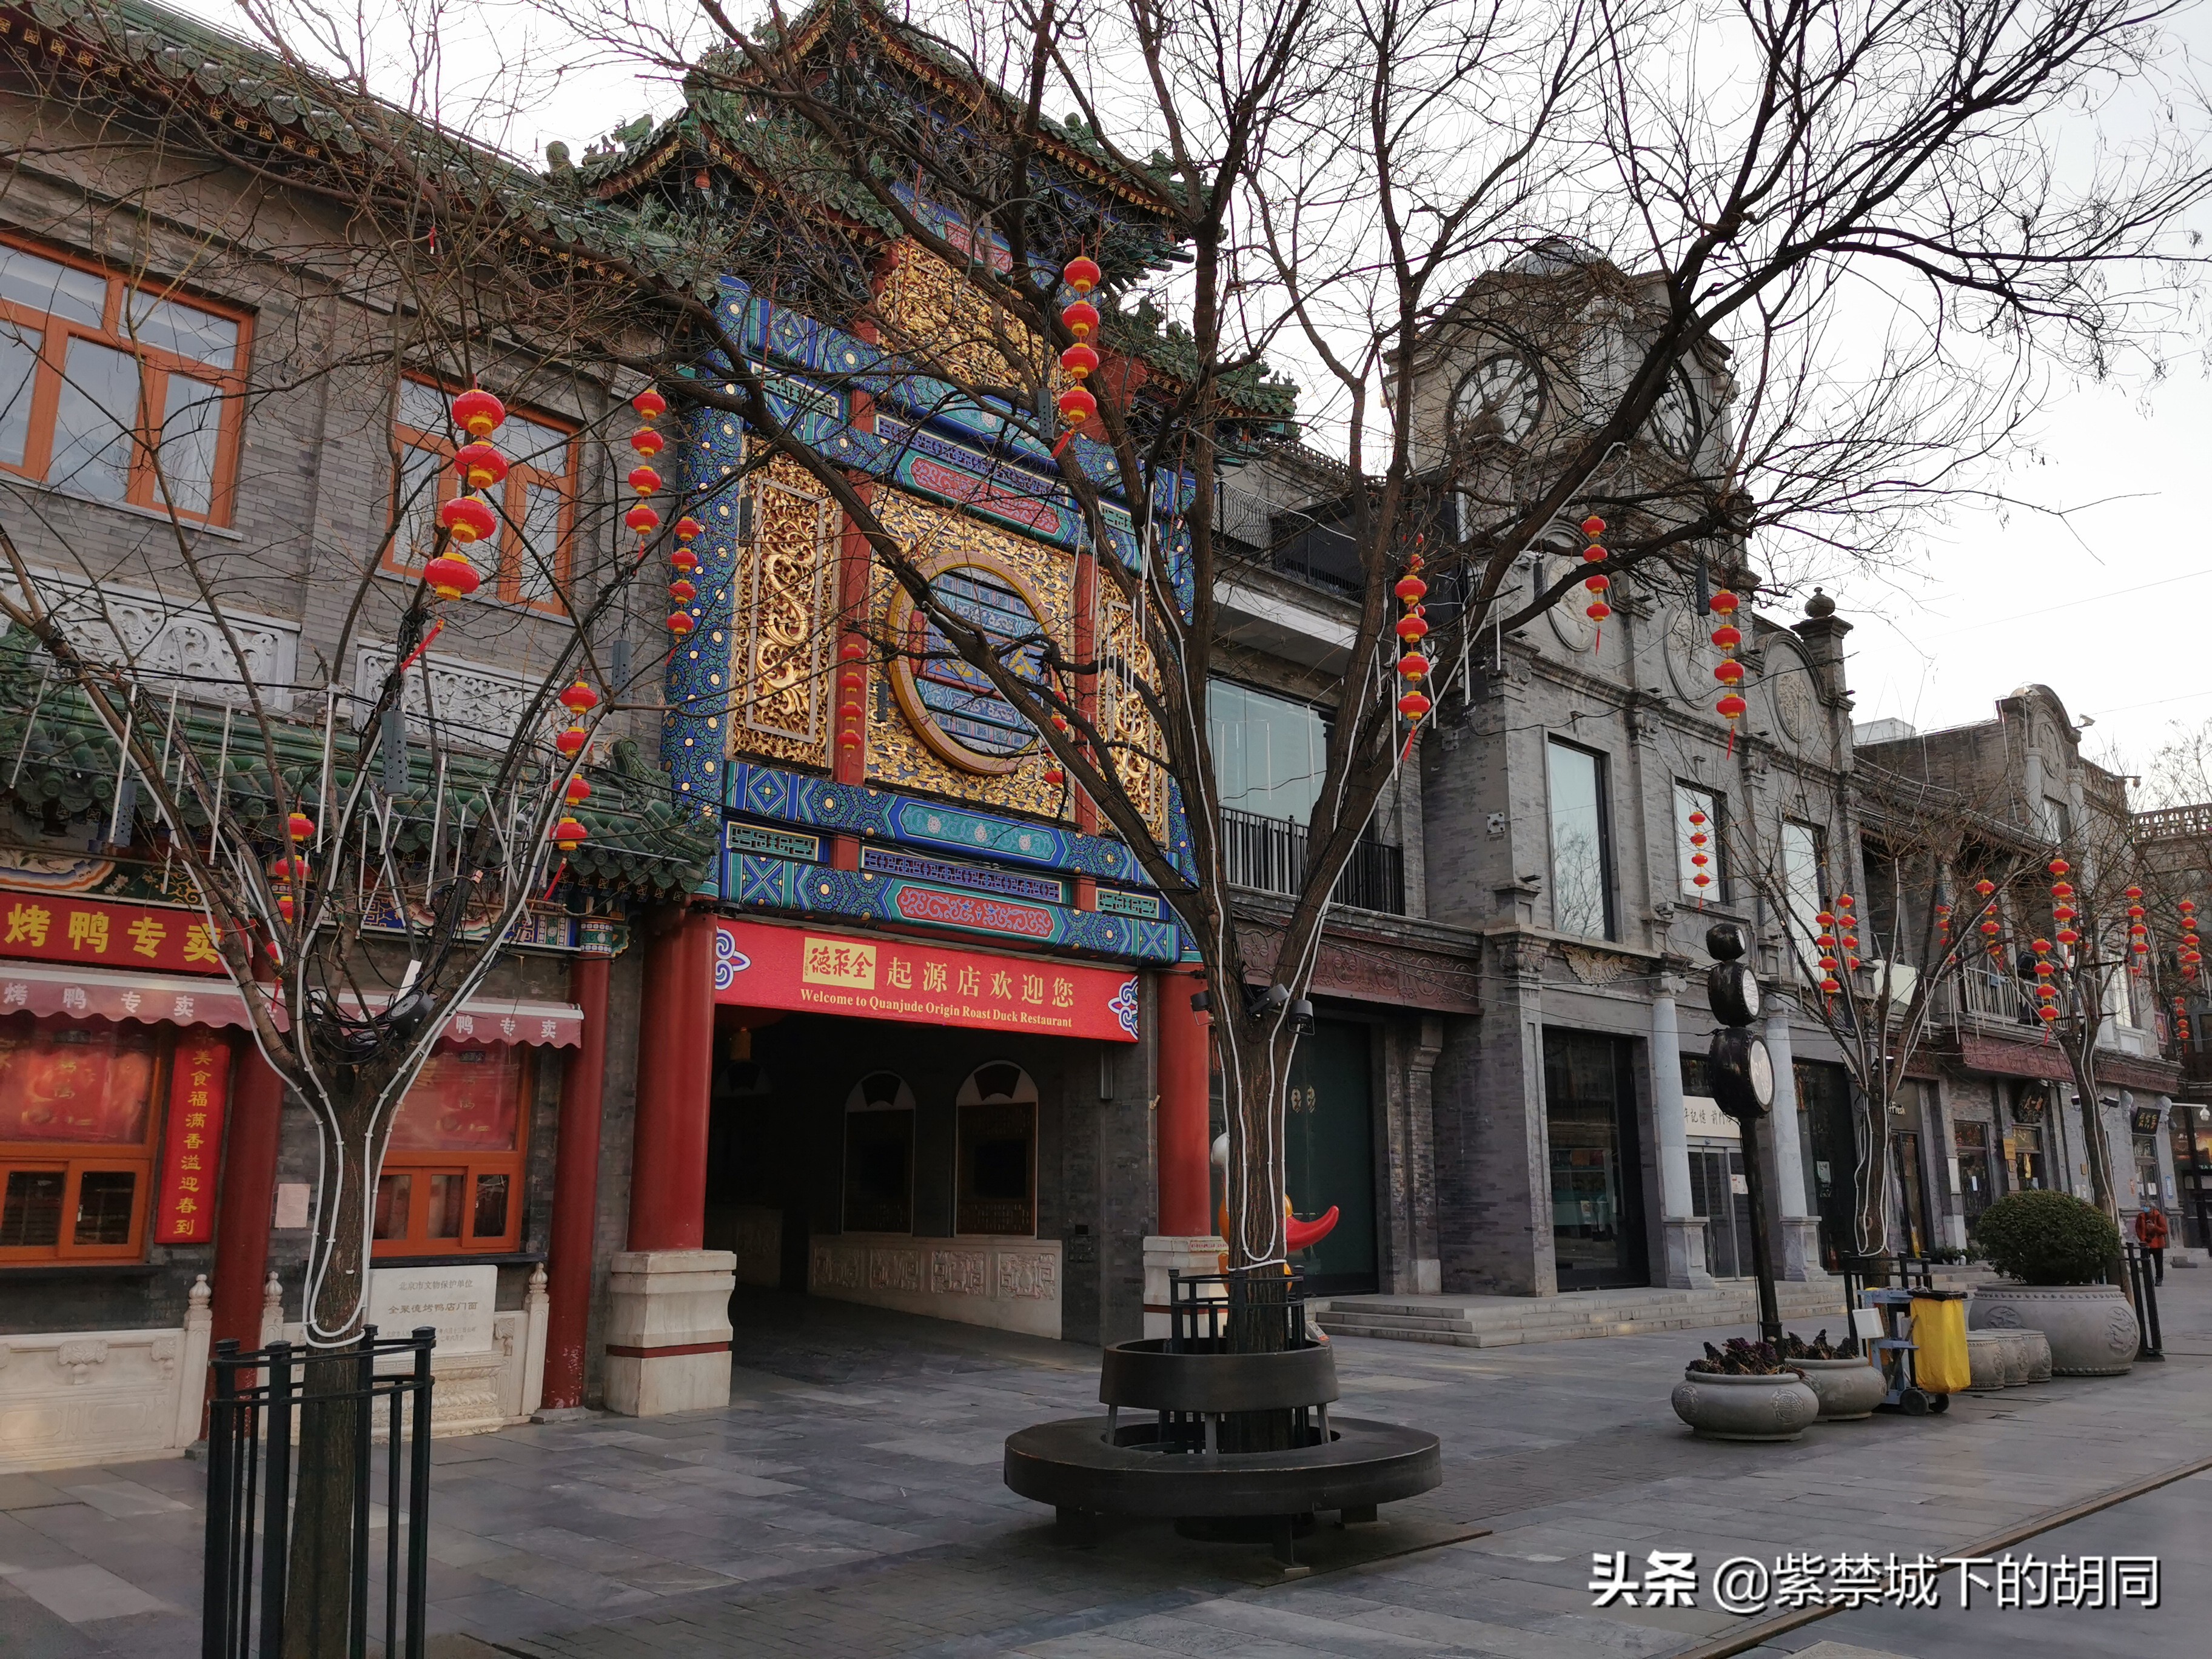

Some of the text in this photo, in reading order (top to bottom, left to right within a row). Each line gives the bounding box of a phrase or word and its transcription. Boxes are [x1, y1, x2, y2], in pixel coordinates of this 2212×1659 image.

[4, 903, 223, 964] 烤鸭专卖
[886, 956, 1074, 1008] 起源店欢迎您
[800, 988, 1073, 1028] Welcome to Quanjude Origin Roast Duck Restaurant
[399, 1279, 474, 1291] 北京市文物保护单位
[388, 1301, 478, 1315] 全聚德烤鸭店门面
